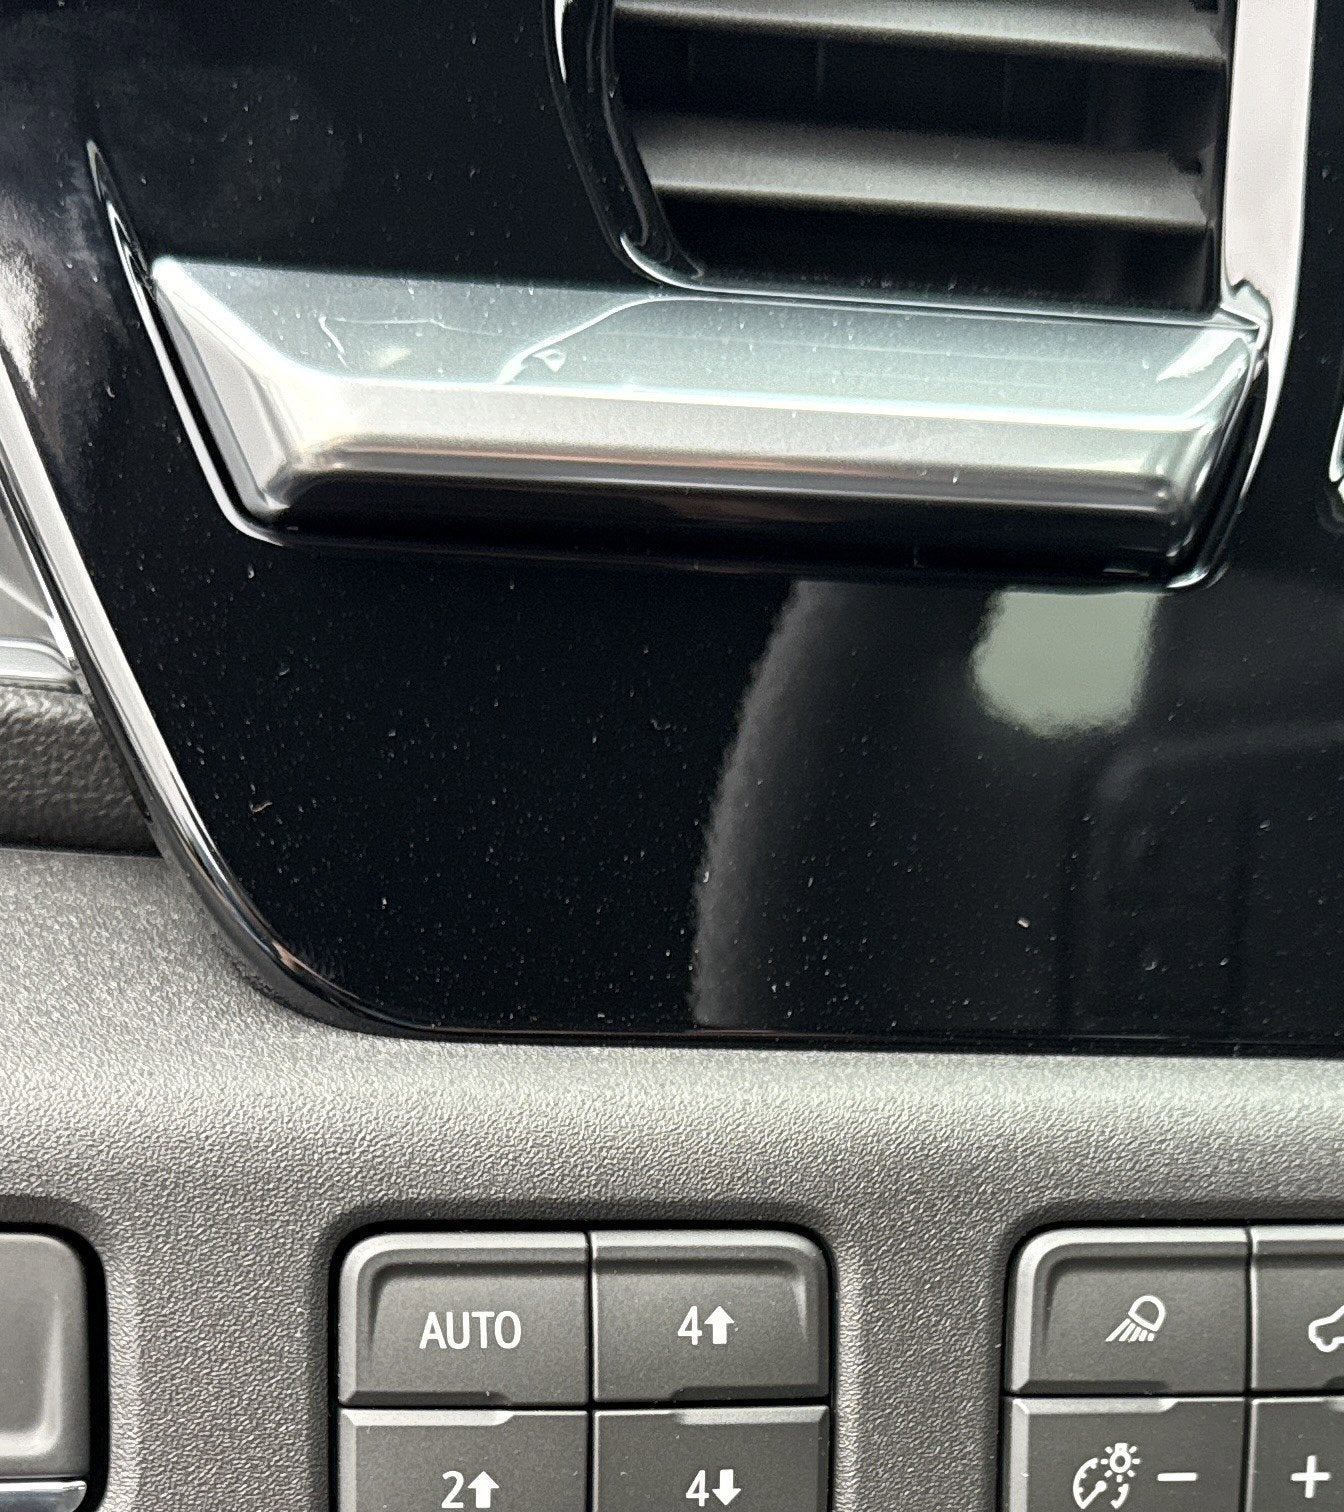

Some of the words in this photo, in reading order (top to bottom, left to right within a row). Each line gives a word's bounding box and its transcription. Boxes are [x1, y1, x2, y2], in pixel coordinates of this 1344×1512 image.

[418, 1310, 523, 1350] AUTO
[677, 1305, 704, 1346] 4
[441, 1470, 466, 1510] 2
[685, 1469, 710, 1507] 4
